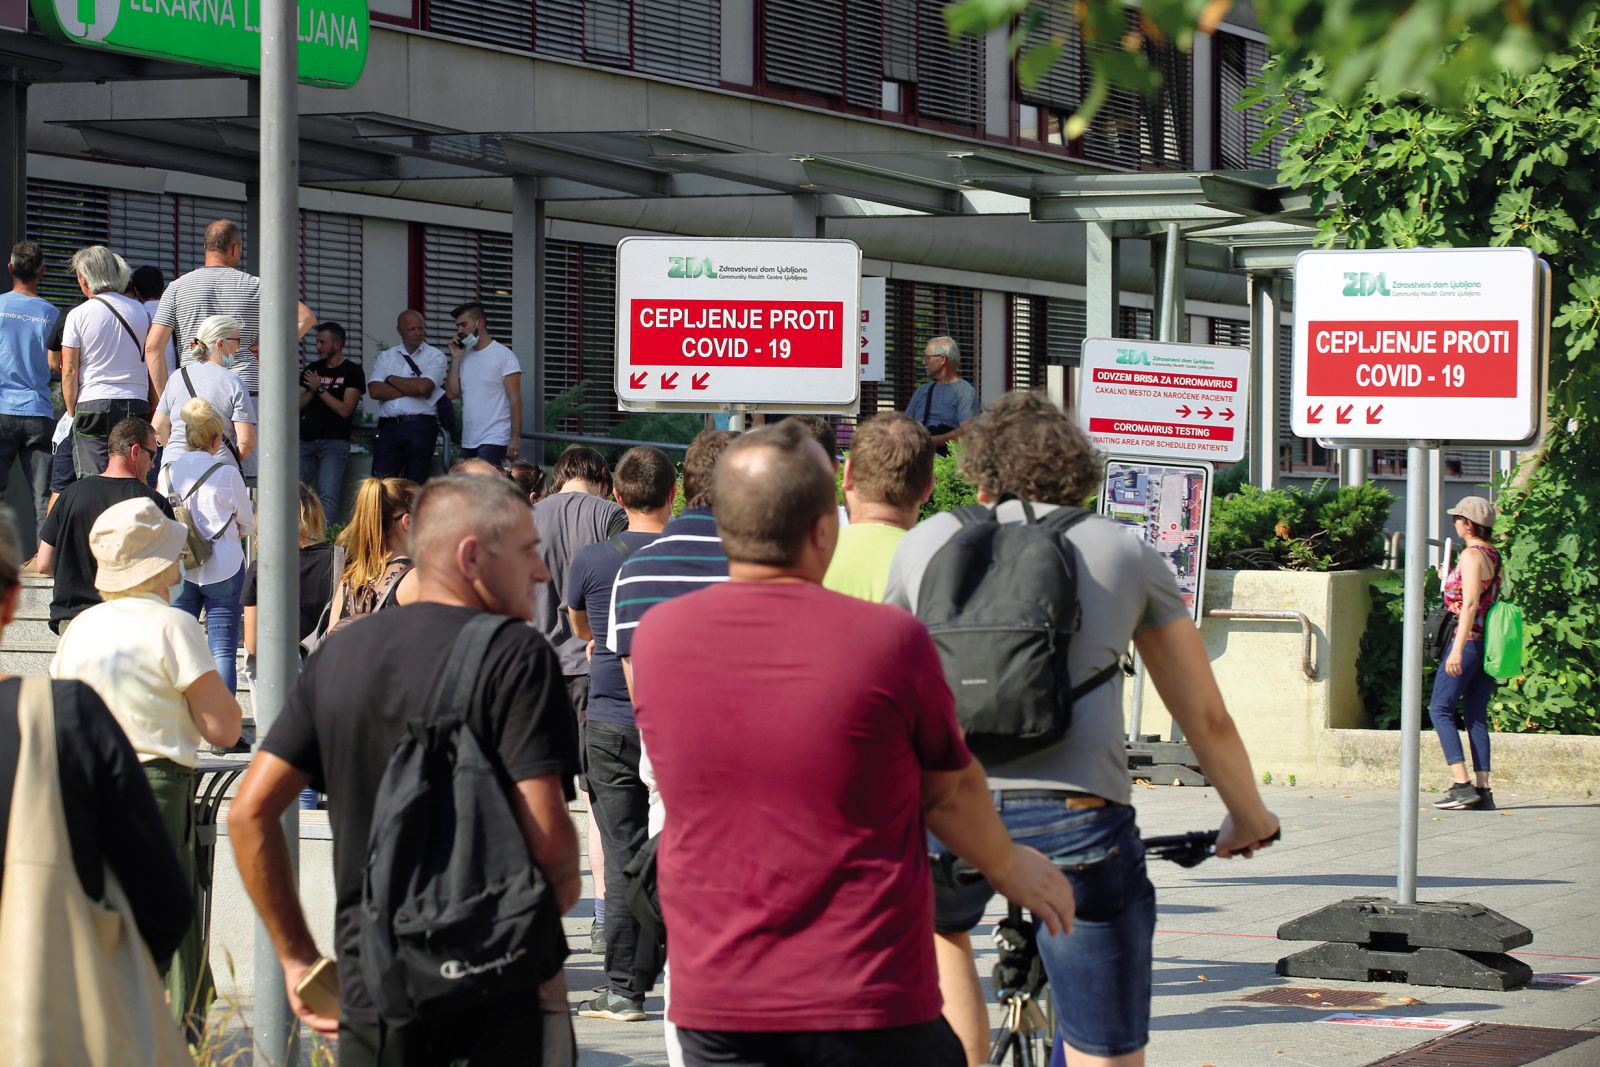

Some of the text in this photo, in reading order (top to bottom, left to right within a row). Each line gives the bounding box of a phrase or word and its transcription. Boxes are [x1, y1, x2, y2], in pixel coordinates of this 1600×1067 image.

[244, 0, 360, 52] LLJANA
[719, 265, 758, 273] Zdravstveni
[777, 265, 808, 275] Ljubljana
[1433, 280, 1448, 289] dom
[639, 307, 834, 330] CEPLJENJE PROTI
[681, 337, 748, 358] COVID
[768, 338, 791, 359] 19
[1315, 330, 1510, 354] CEPLJENJE PROTI
[1097, 371, 1233, 389] ODVZEM BRISA ZA KORONAVIRUS
[1355, 363, 1422, 387] COVID
[1441, 364, 1465, 388] 19
[1095, 385, 1127, 396] ČAKALNO
[1129, 389, 1151, 397] MESTO
[1163, 391, 1200, 401] NAROČENE
[1201, 393, 1233, 403] PACIENTE
[1113, 422, 1210, 437] CORONAVIRUS TESTING
[1092, 436, 1229, 452] WAITING AREA FOR SCHEDULED PATIENTS
